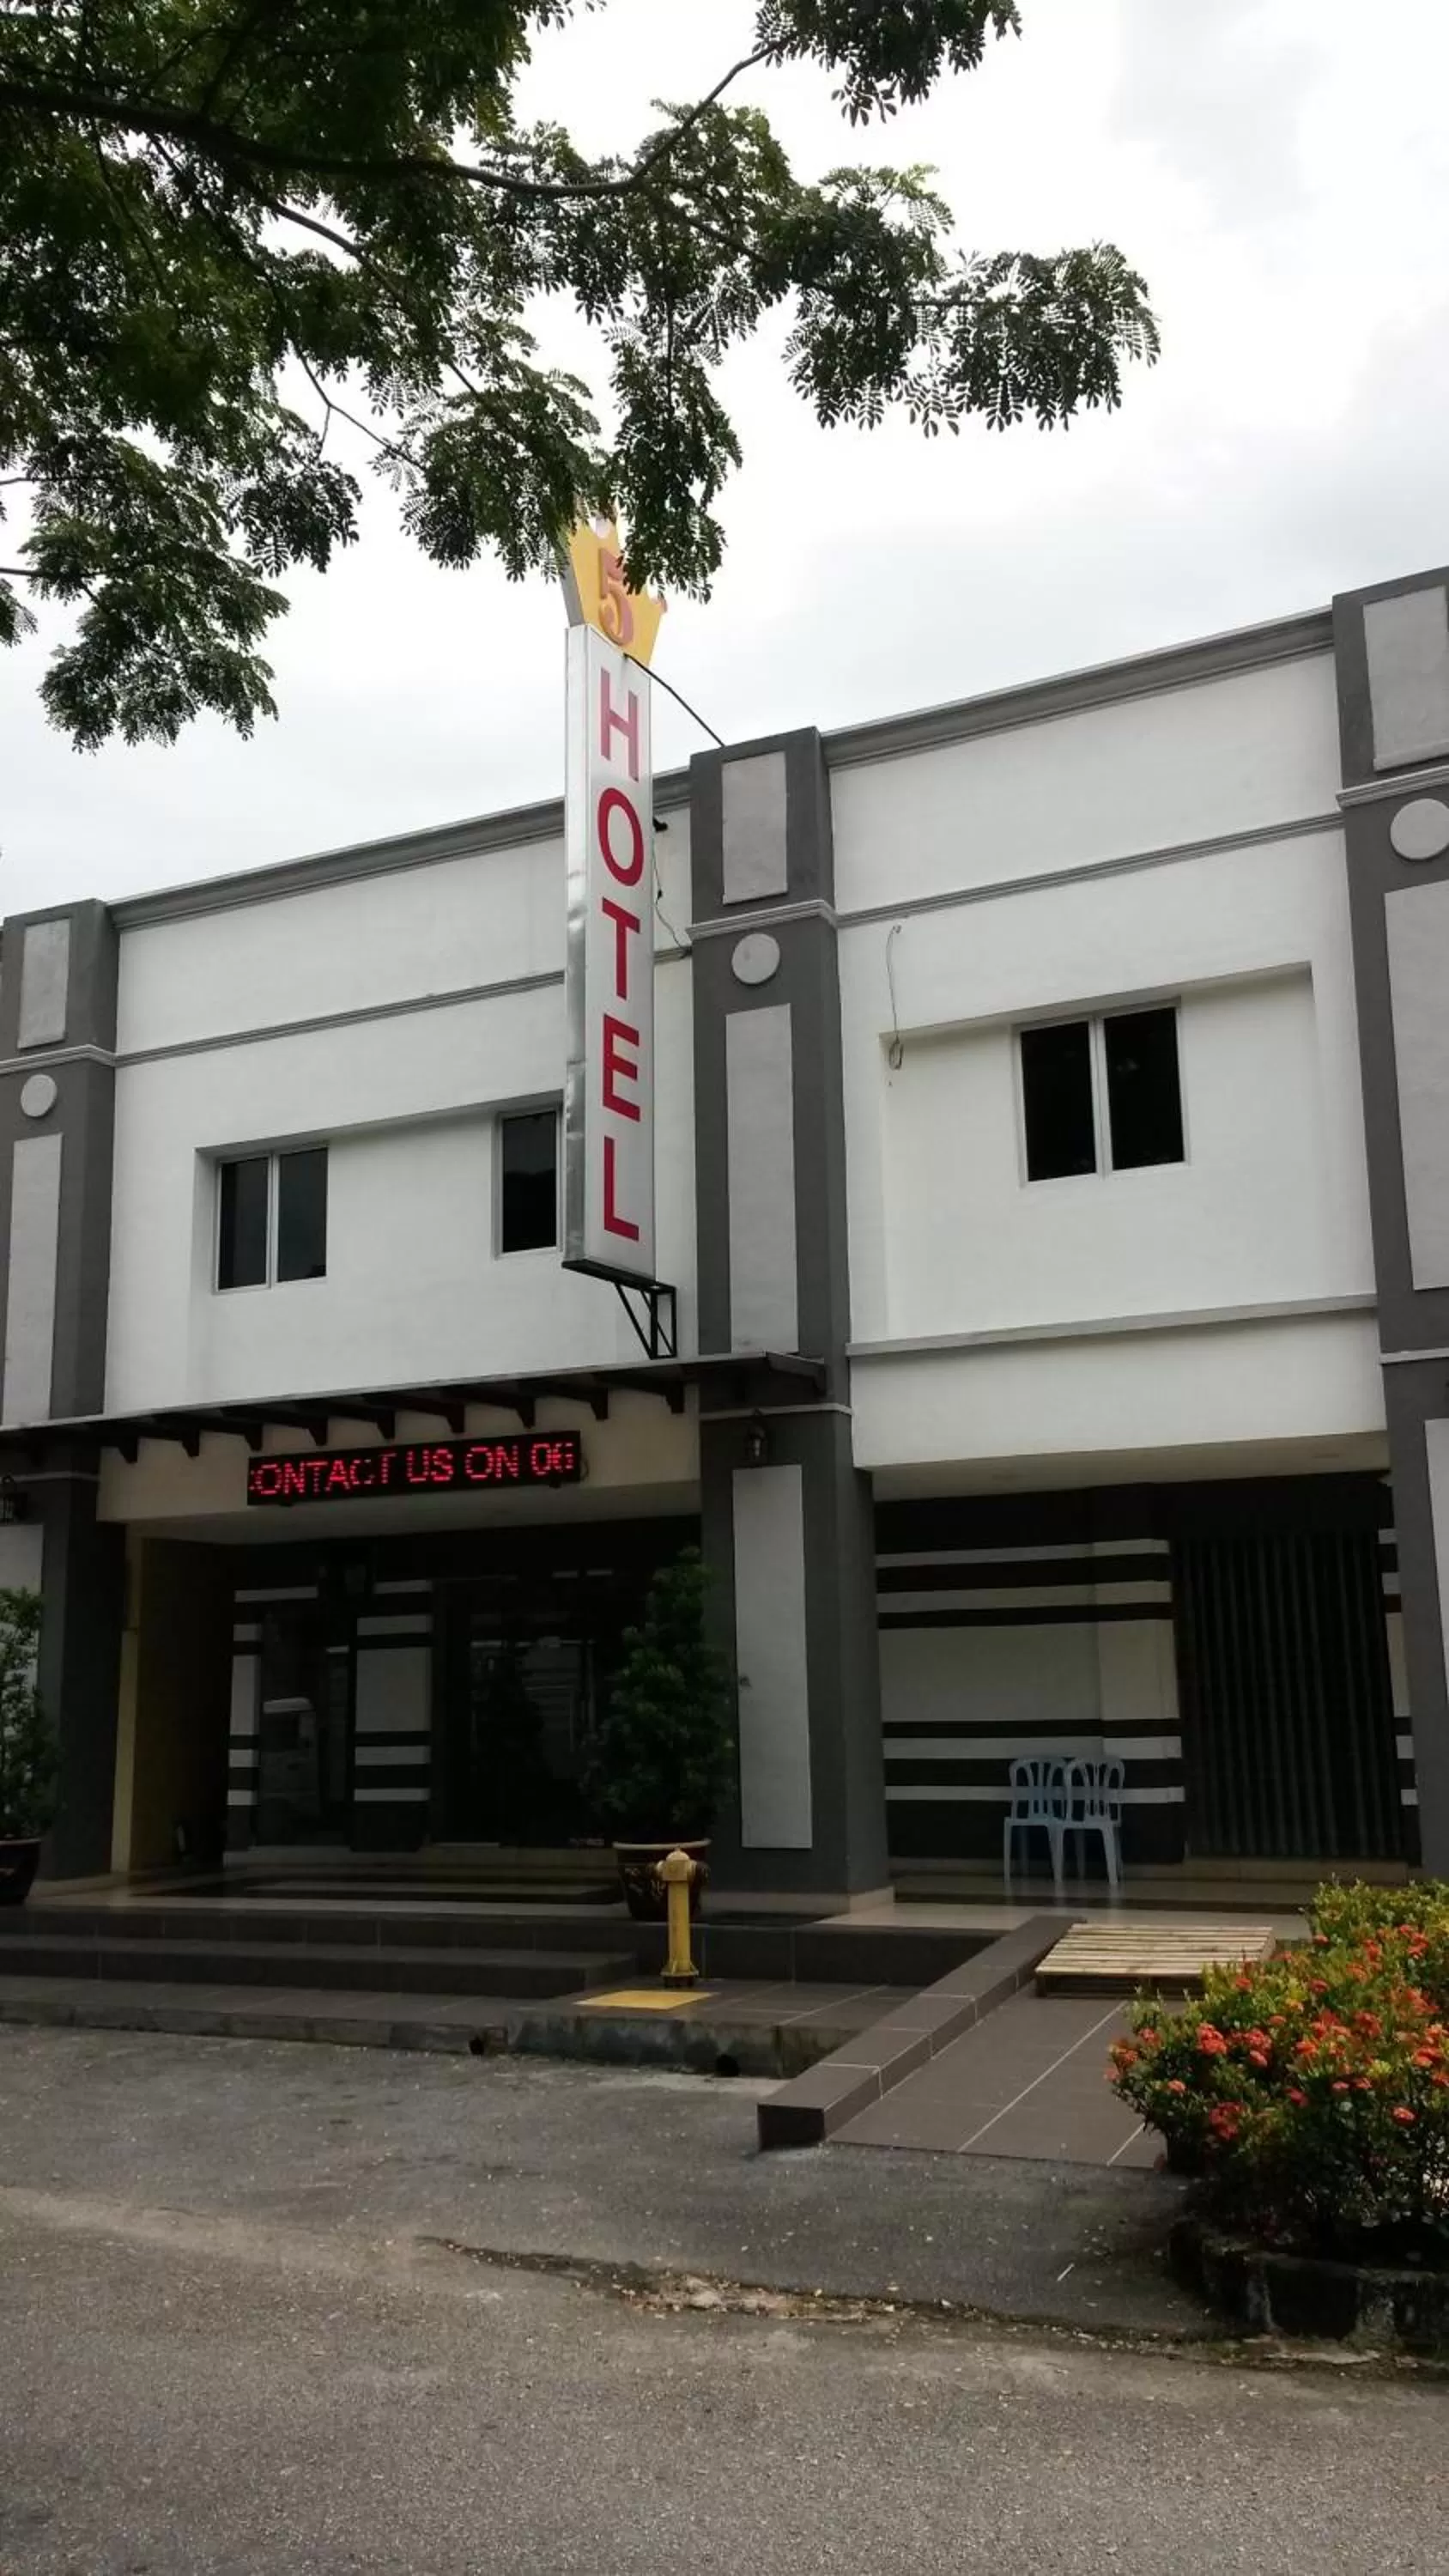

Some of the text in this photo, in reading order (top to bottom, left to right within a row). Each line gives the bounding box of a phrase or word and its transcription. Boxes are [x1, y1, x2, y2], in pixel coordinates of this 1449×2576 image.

[597, 547, 634, 646] 5
[597, 667, 644, 1242] HOTEL
[249, 1452, 397, 1495] ONTACT
[406, 1448, 455, 1484] US
[464, 1444, 519, 1479] ON
